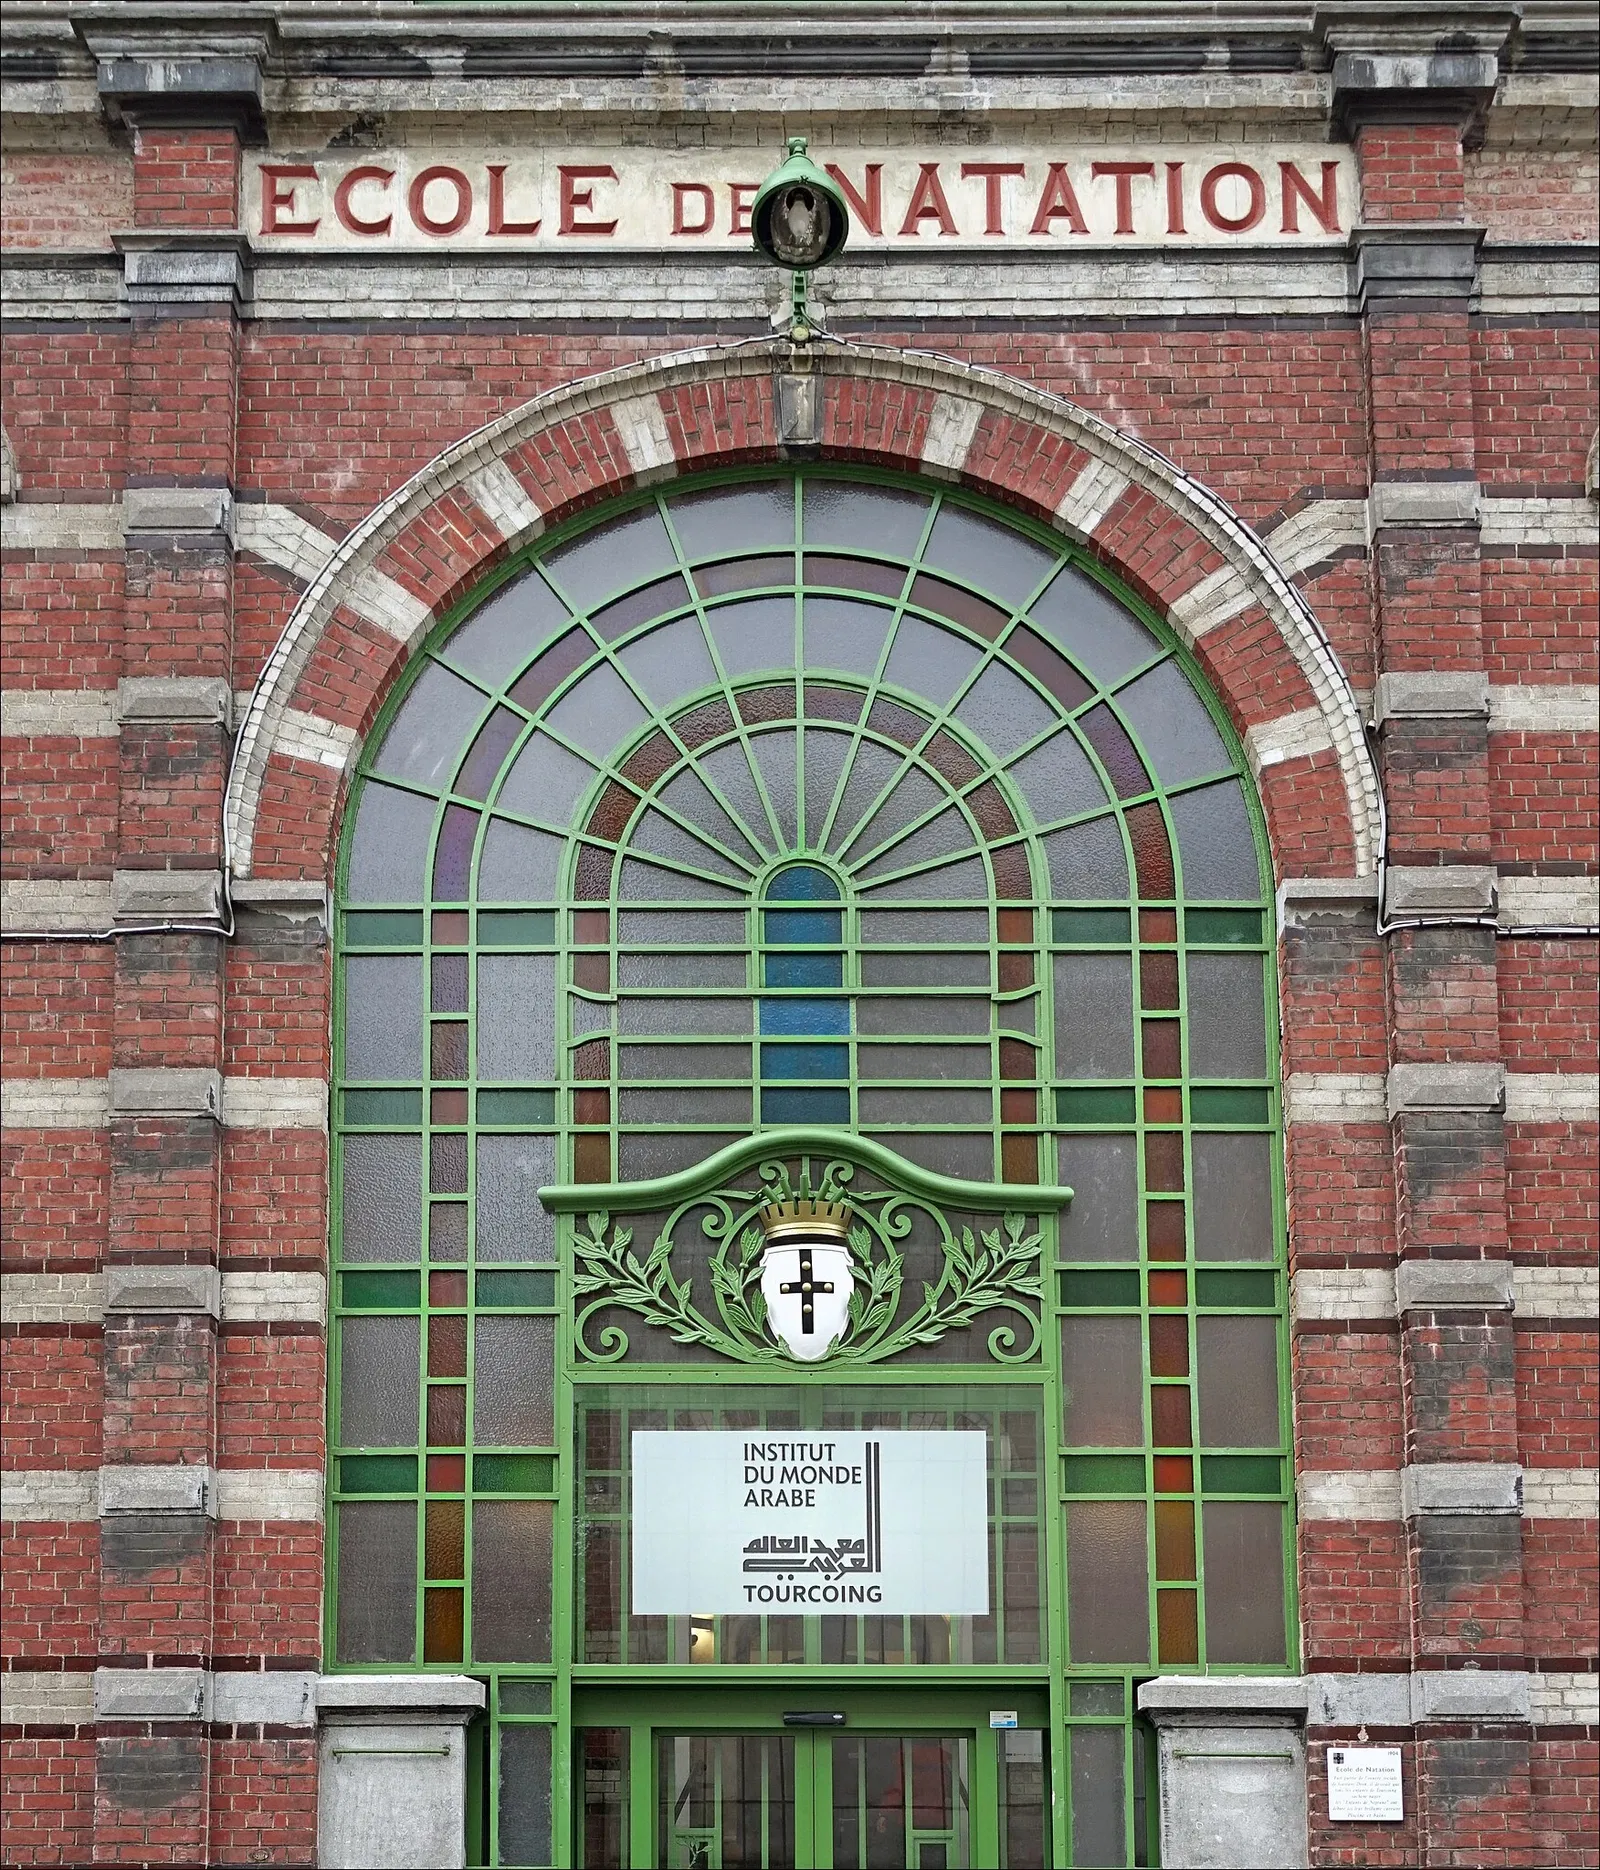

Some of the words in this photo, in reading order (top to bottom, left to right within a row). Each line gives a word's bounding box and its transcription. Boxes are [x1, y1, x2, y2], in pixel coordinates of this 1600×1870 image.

[257, 164, 620, 237] ECOLE
[669, 182, 758, 237] DE
[824, 161, 1343, 236] NATATION
[743, 1443, 836, 1462] INSTITUT
[744, 1466, 774, 1484] DU
[779, 1466, 862, 1484] MONDE
[743, 1489, 816, 1507] ARABE
[743, 1585, 882, 1603] TOURCOING
